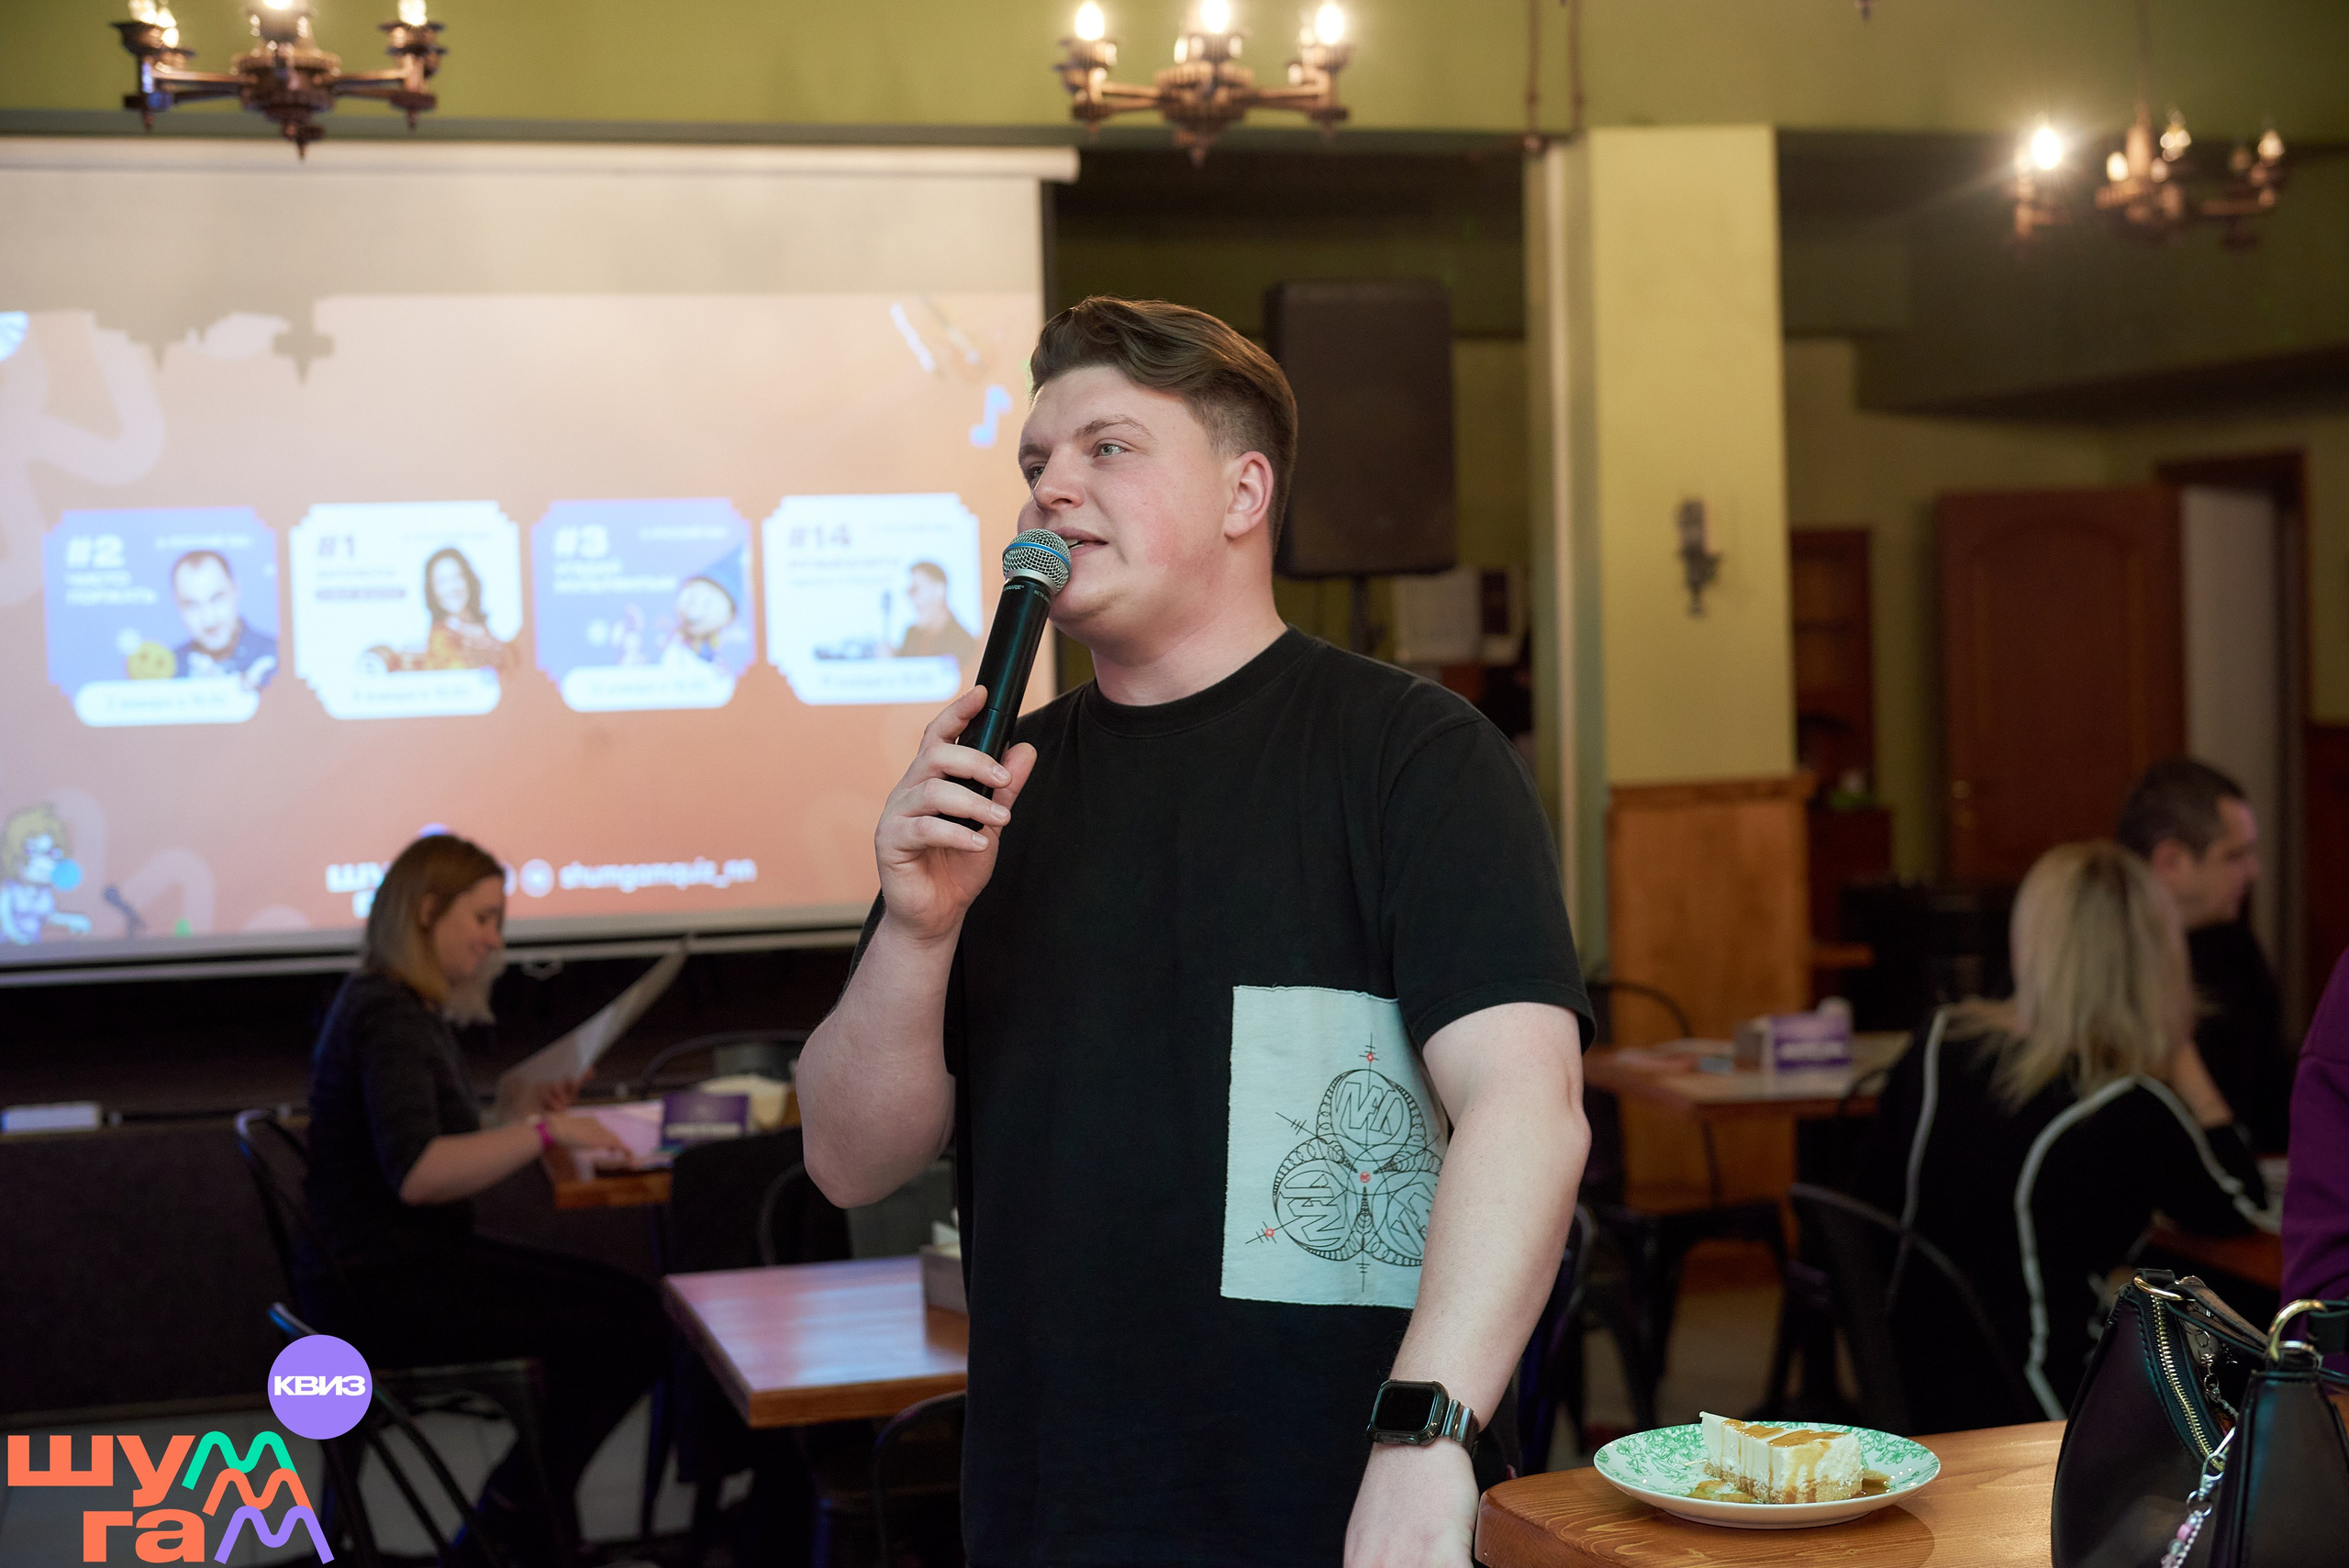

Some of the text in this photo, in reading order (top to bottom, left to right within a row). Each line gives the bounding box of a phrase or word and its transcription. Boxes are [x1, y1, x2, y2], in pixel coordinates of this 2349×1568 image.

[66, 534, 125, 568] #2
[317, 534, 355, 558] #1
[554, 524, 608, 558] #3
[787, 522, 853, 550] #14
